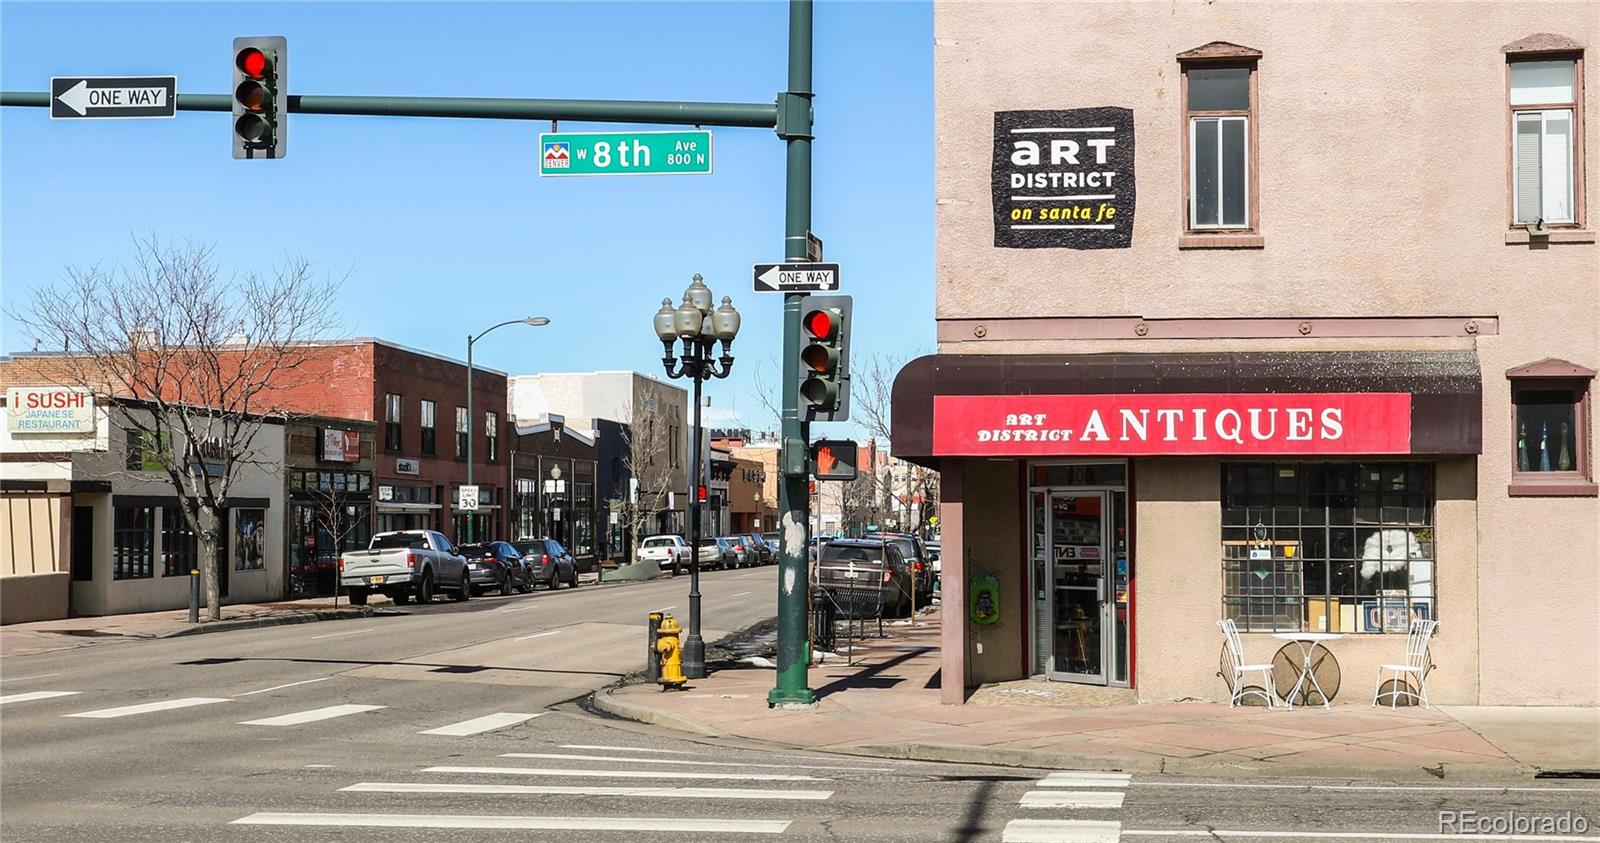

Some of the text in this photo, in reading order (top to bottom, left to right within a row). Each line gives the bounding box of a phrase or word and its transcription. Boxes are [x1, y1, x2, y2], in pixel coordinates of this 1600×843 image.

[89, 90, 161, 105] ONE WAY
[576, 139, 697, 168] W 8th Ave
[667, 153, 705, 165] 800 N
[544, 159, 569, 168] DENVER
[1011, 172, 1116, 188] DISTRICT
[1011, 203, 1116, 222] on santa fe
[779, 271, 830, 283] ONE WAY
[27, 391, 84, 408] SUSHI
[25, 410, 74, 419] JAPANESE
[1006, 413, 1047, 426] ART
[18, 419, 81, 429] RESTAURANT
[977, 408, 1343, 444] DISTRICT ANTIQUES
[462, 499, 476, 508] 30
